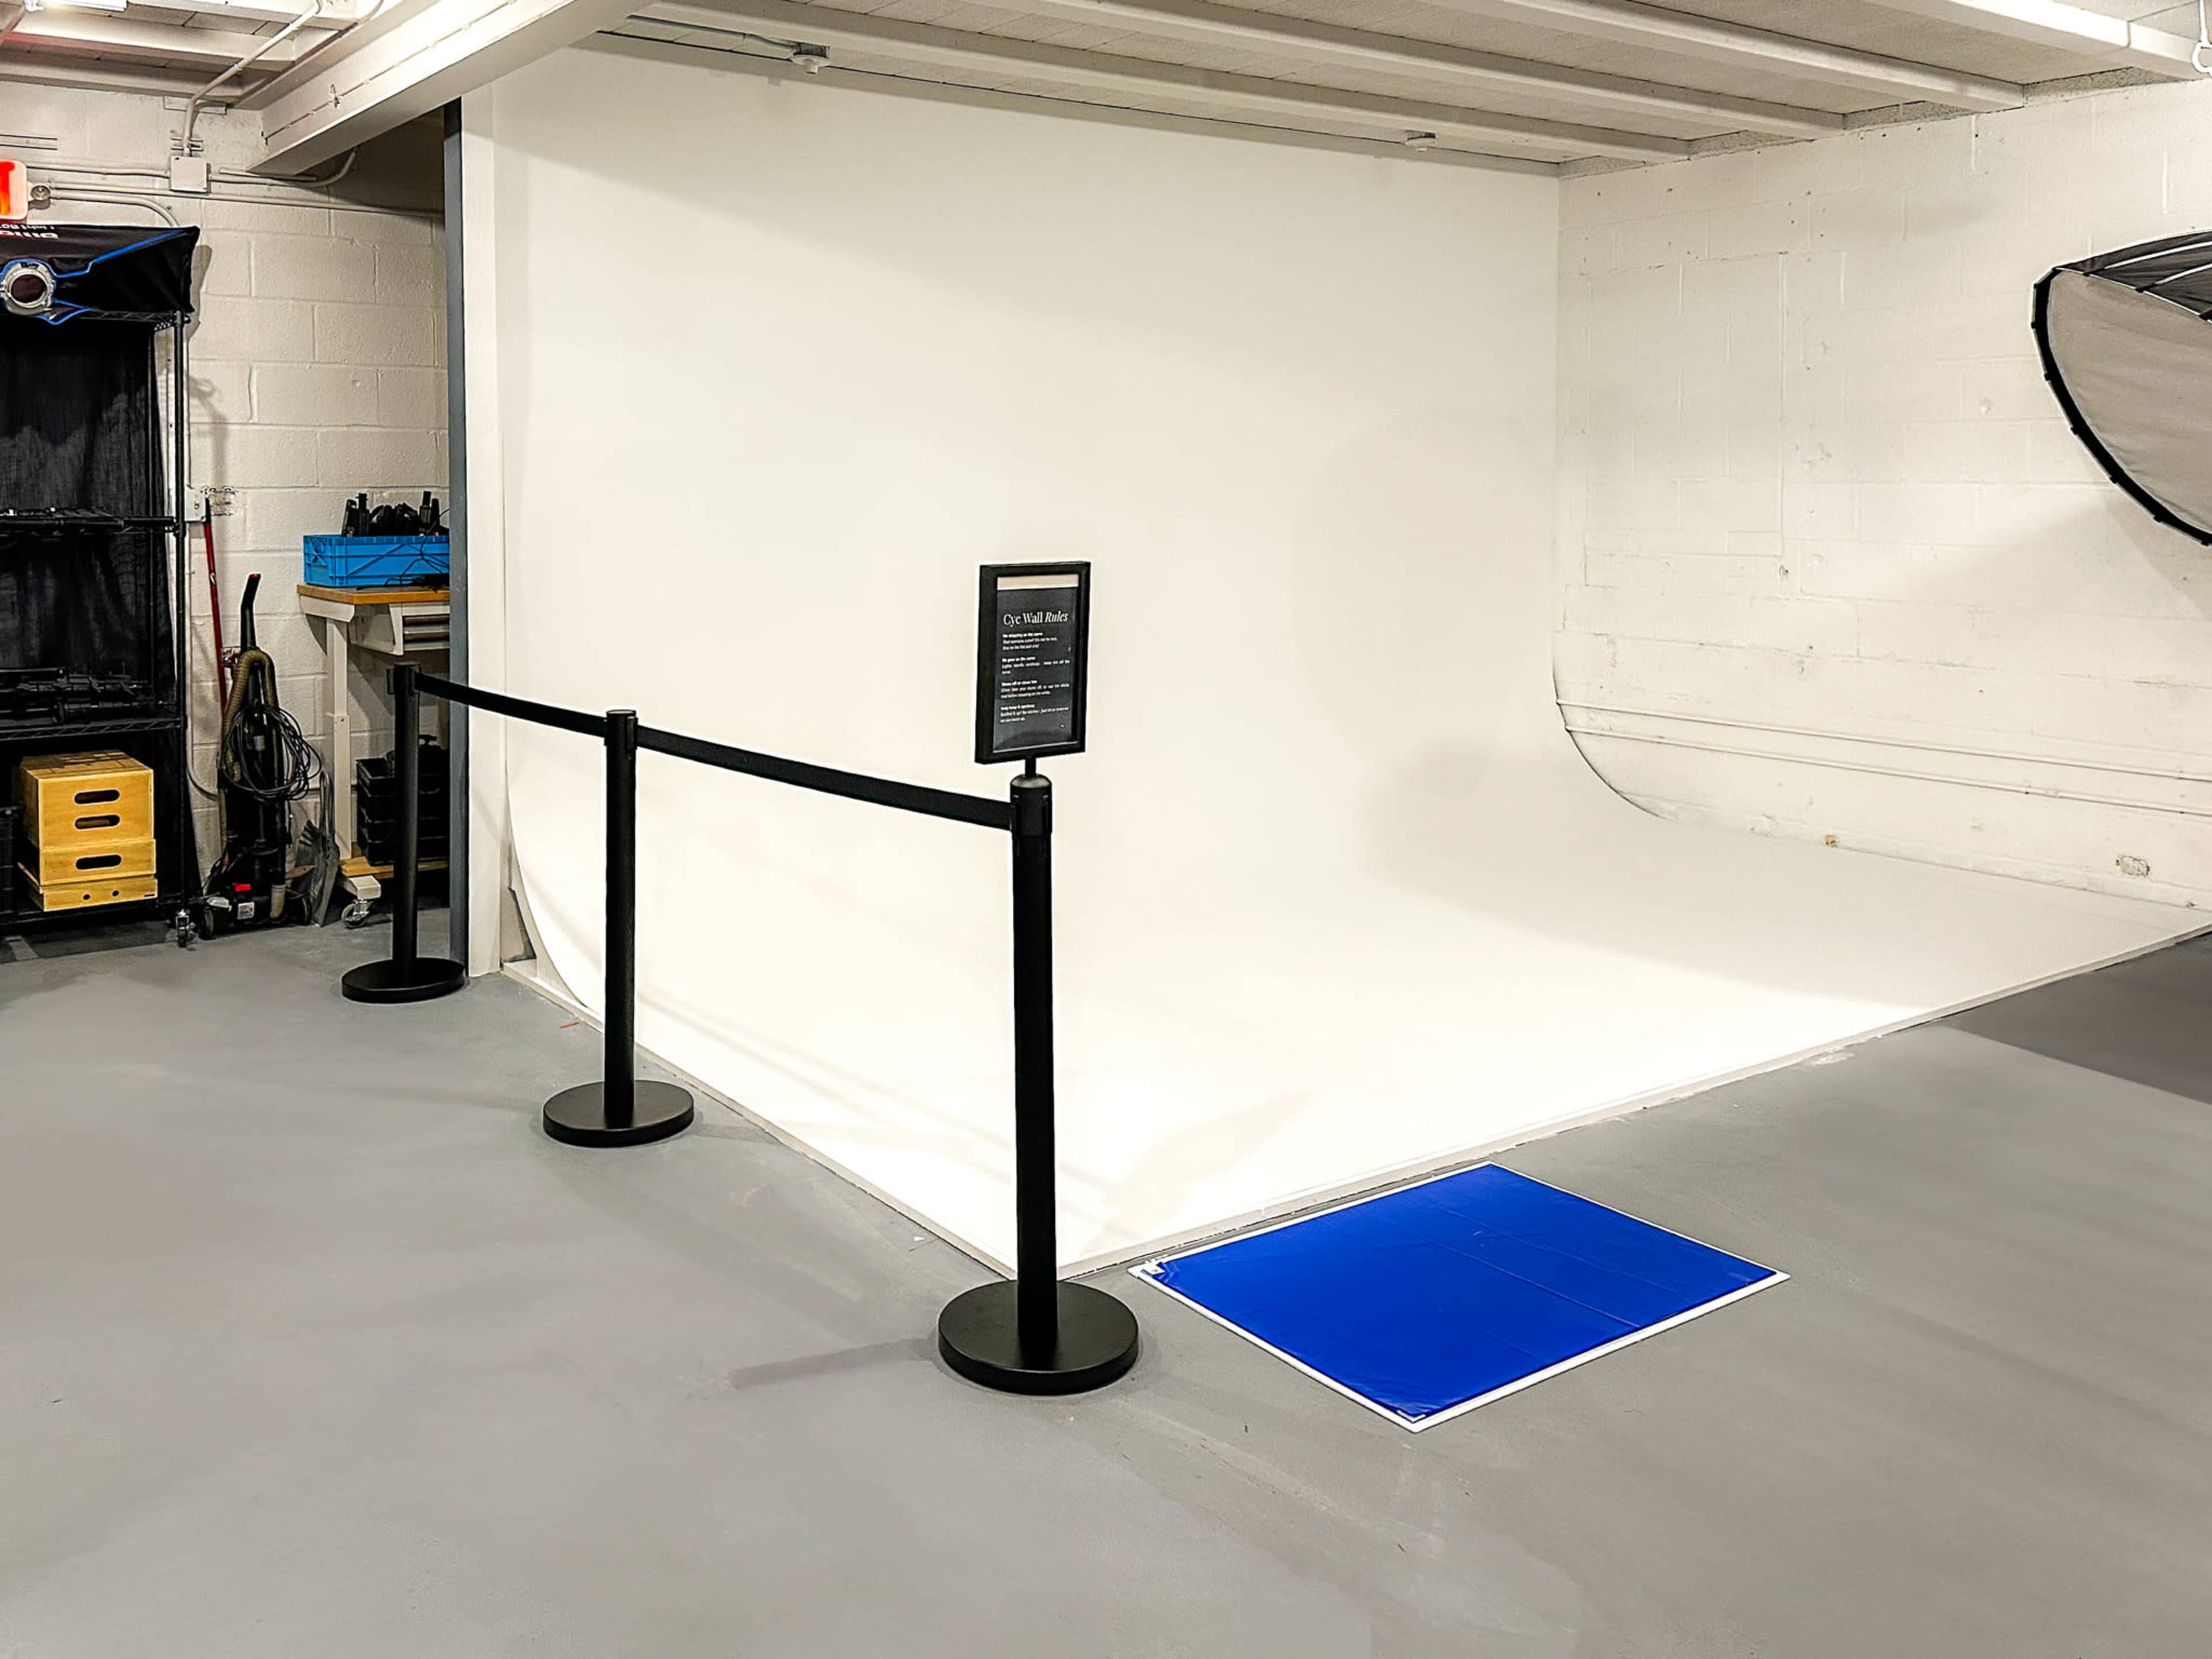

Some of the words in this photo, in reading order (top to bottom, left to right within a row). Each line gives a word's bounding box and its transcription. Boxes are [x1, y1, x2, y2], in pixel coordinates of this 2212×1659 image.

[1003, 614, 1021, 627] Cyc
[1022, 612, 1043, 624] Wall
[1045, 610, 1069, 623] Rules
